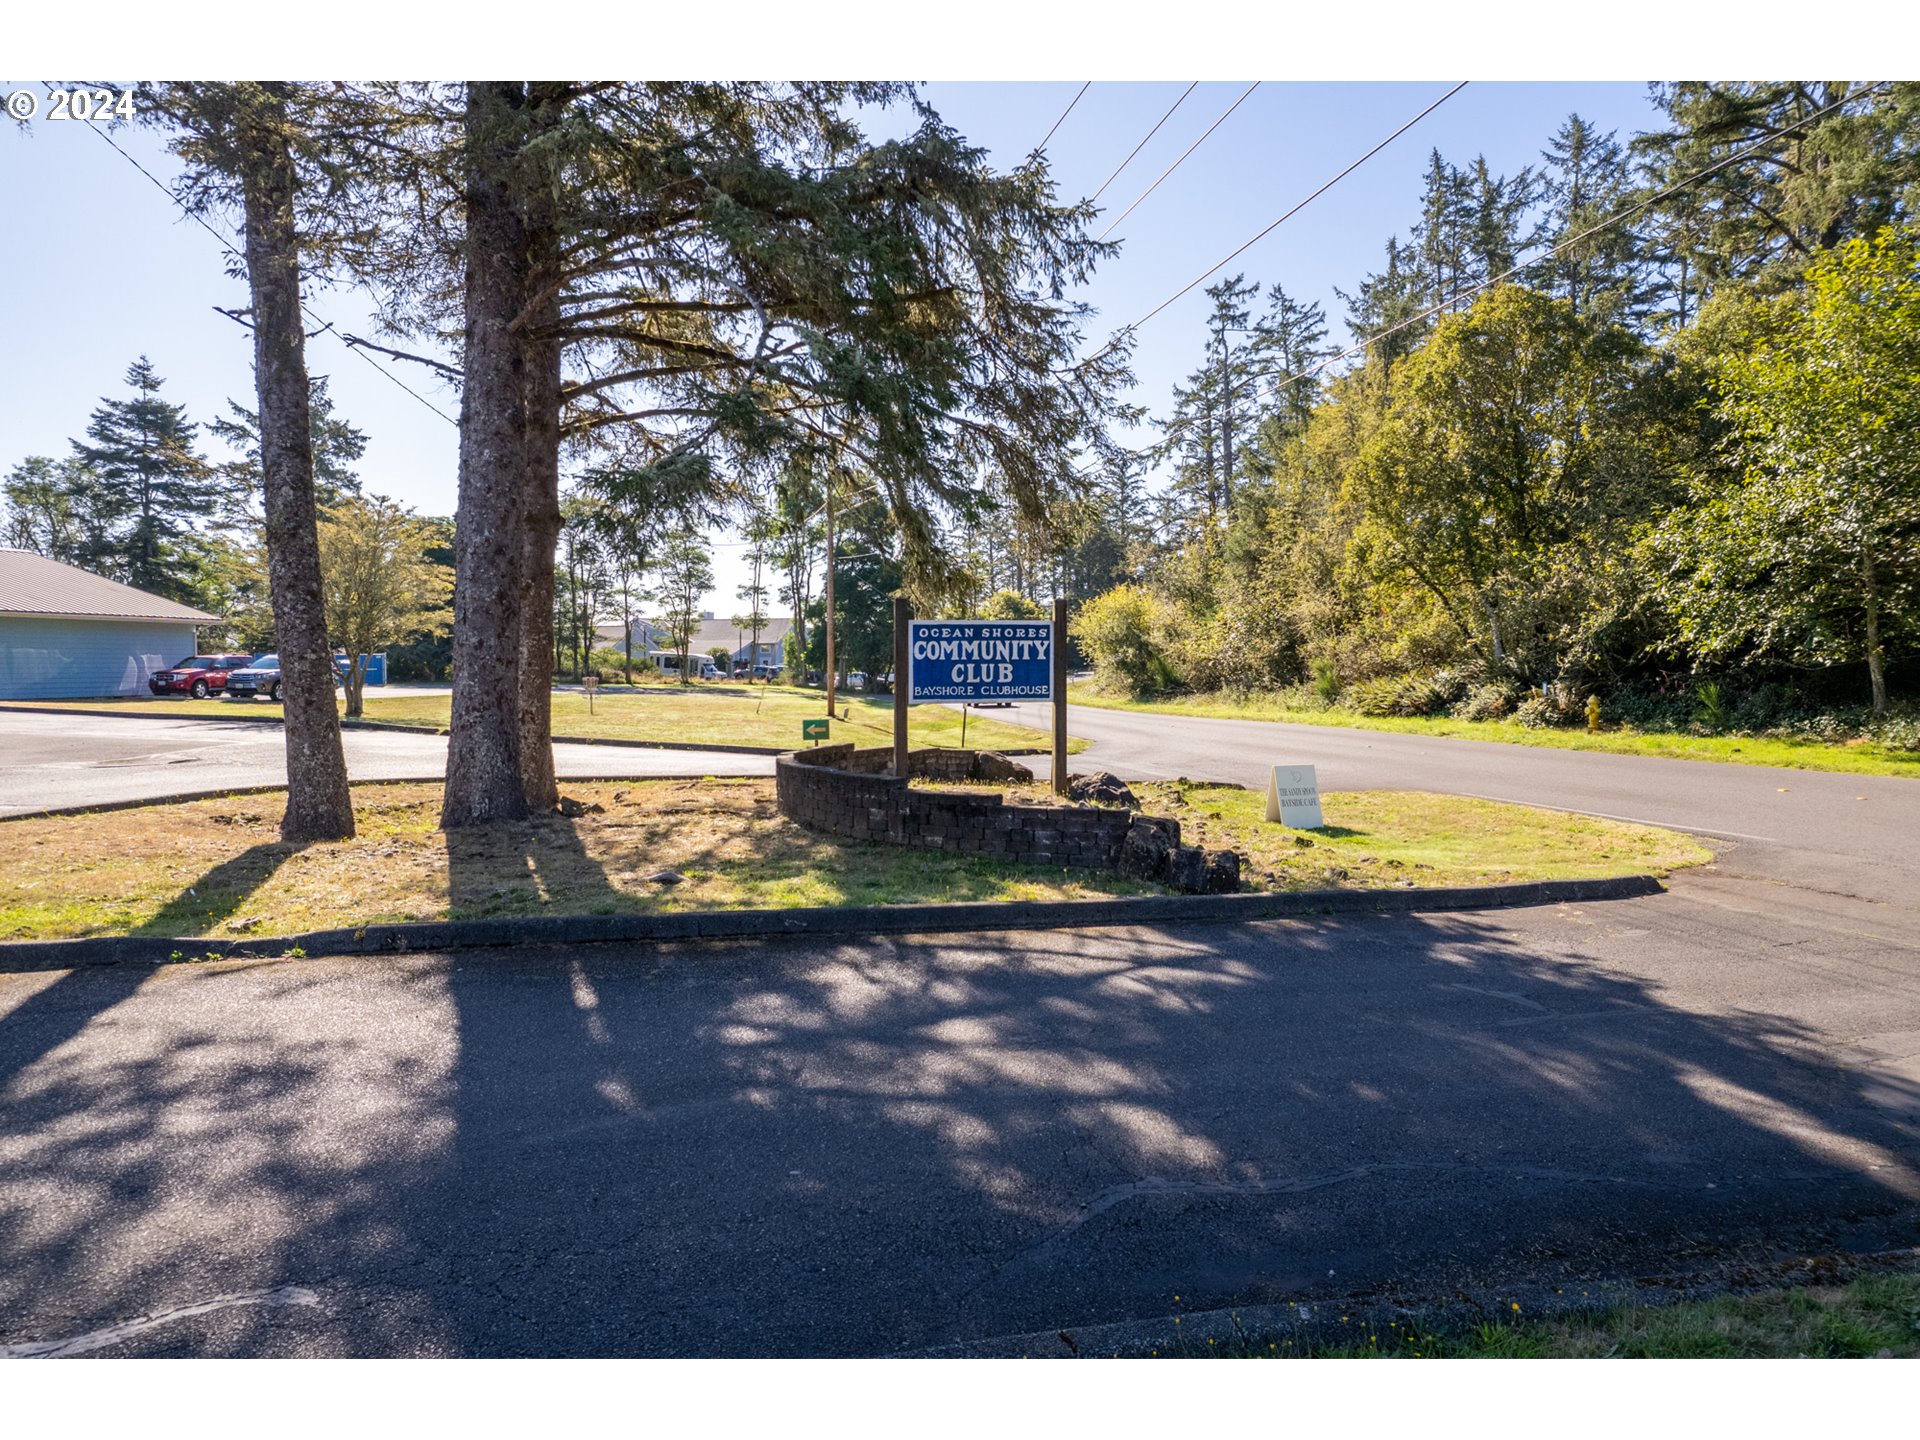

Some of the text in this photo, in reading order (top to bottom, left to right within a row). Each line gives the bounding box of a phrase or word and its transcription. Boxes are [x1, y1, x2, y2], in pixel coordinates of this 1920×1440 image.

[919, 628, 1048, 638] OCEAN SHORES
[913, 640, 1050, 662] COMMUNITY
[951, 663, 1014, 683] CLUB
[914, 685, 1050, 696] BAYSHORE CLUBHOUSE
